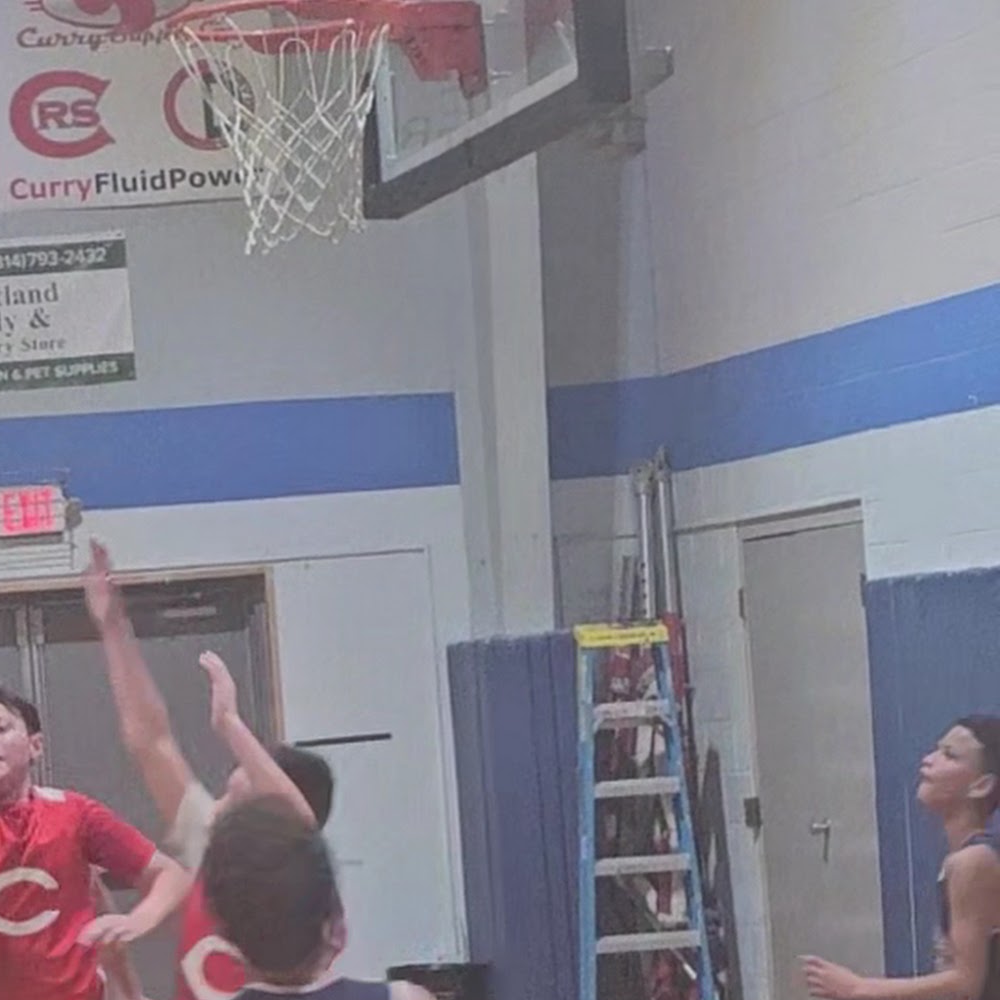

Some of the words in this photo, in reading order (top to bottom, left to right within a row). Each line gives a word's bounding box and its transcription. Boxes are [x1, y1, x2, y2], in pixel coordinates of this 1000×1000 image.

[16, 27, 101, 50] Curry
[29, 307, 51, 330] &
[21, 336, 67, 353] Store
[24, 366, 50, 380] PET
[54, 360, 119, 378] SUPPLIES
